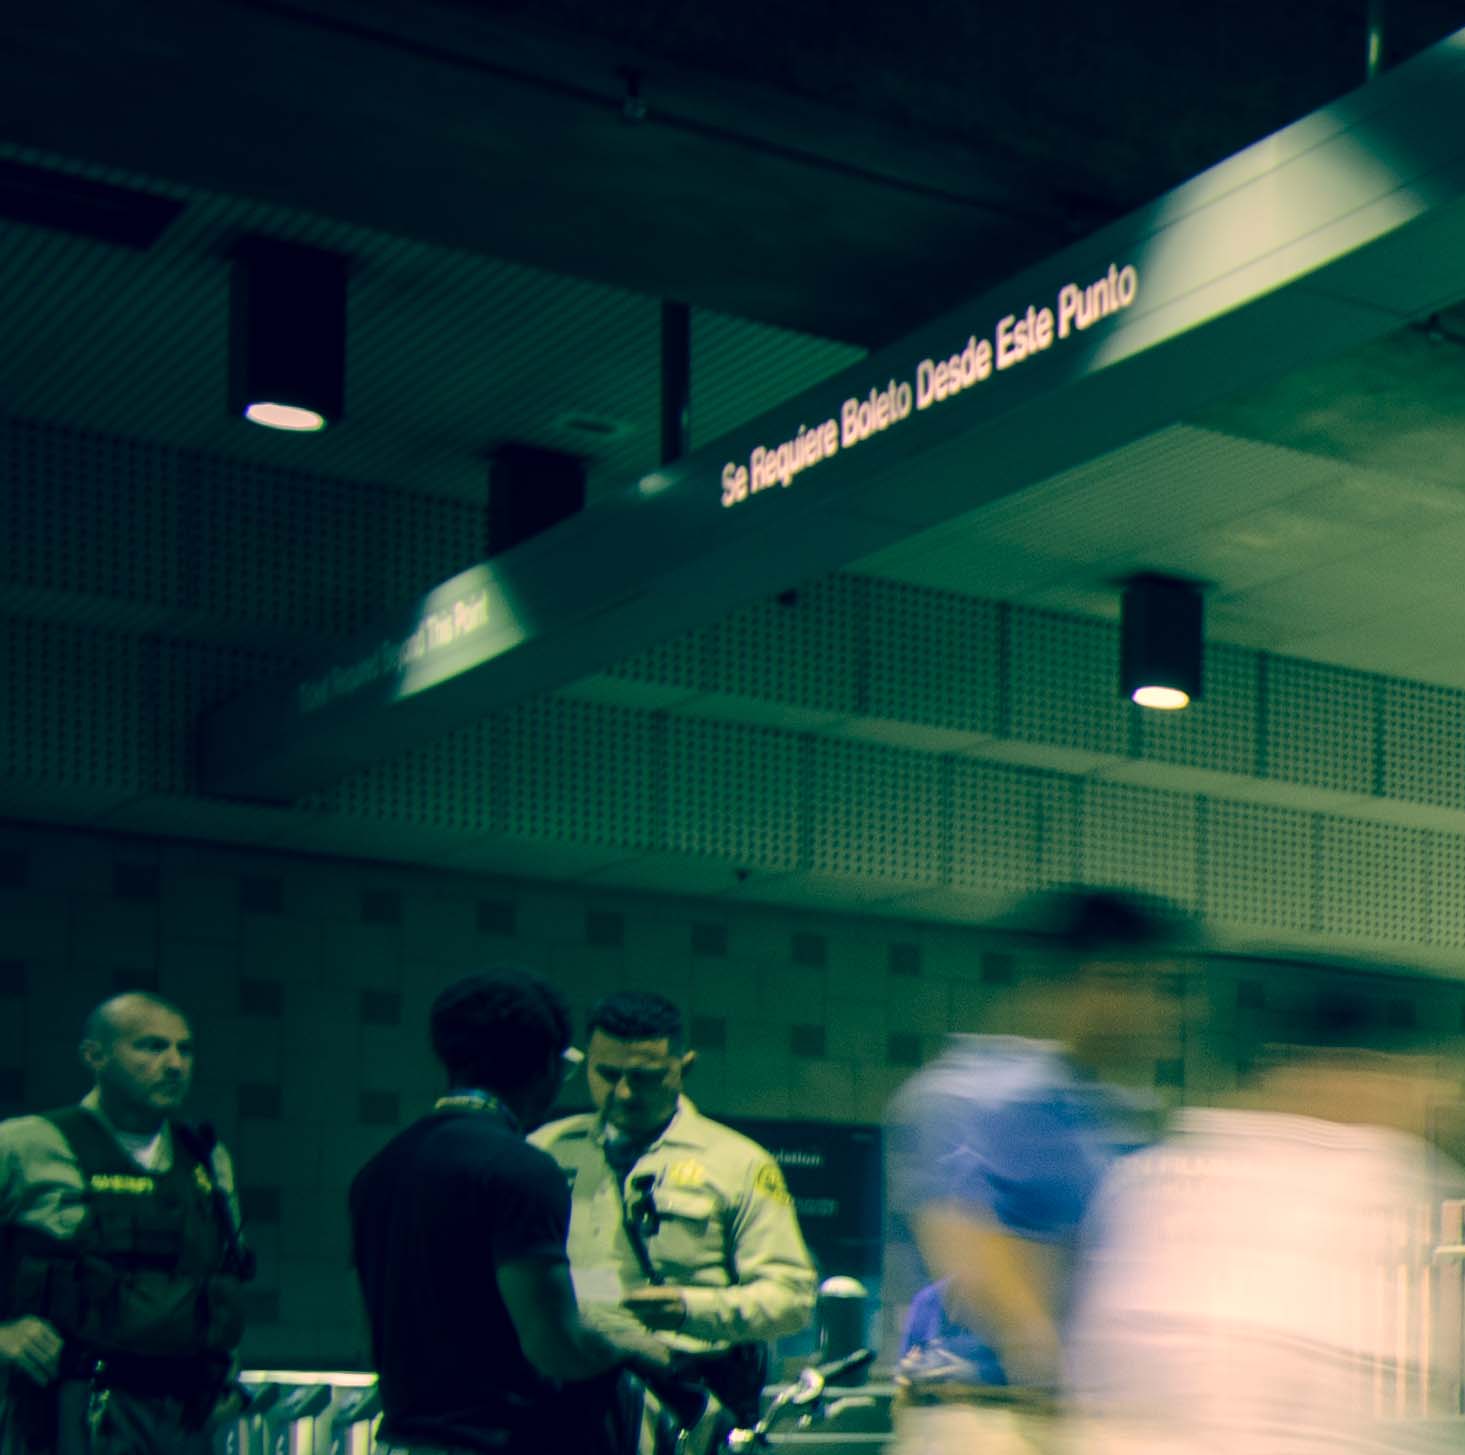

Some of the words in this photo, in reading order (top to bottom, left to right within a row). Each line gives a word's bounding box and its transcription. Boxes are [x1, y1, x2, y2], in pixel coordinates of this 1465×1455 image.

[721, 462, 748, 507] Se
[750, 418, 839, 494] Requiere
[840, 379, 912, 448] Boleto
[916, 335, 993, 410] Desde
[995, 305, 1054, 370] Este
[1058, 262, 1137, 339] Punto
